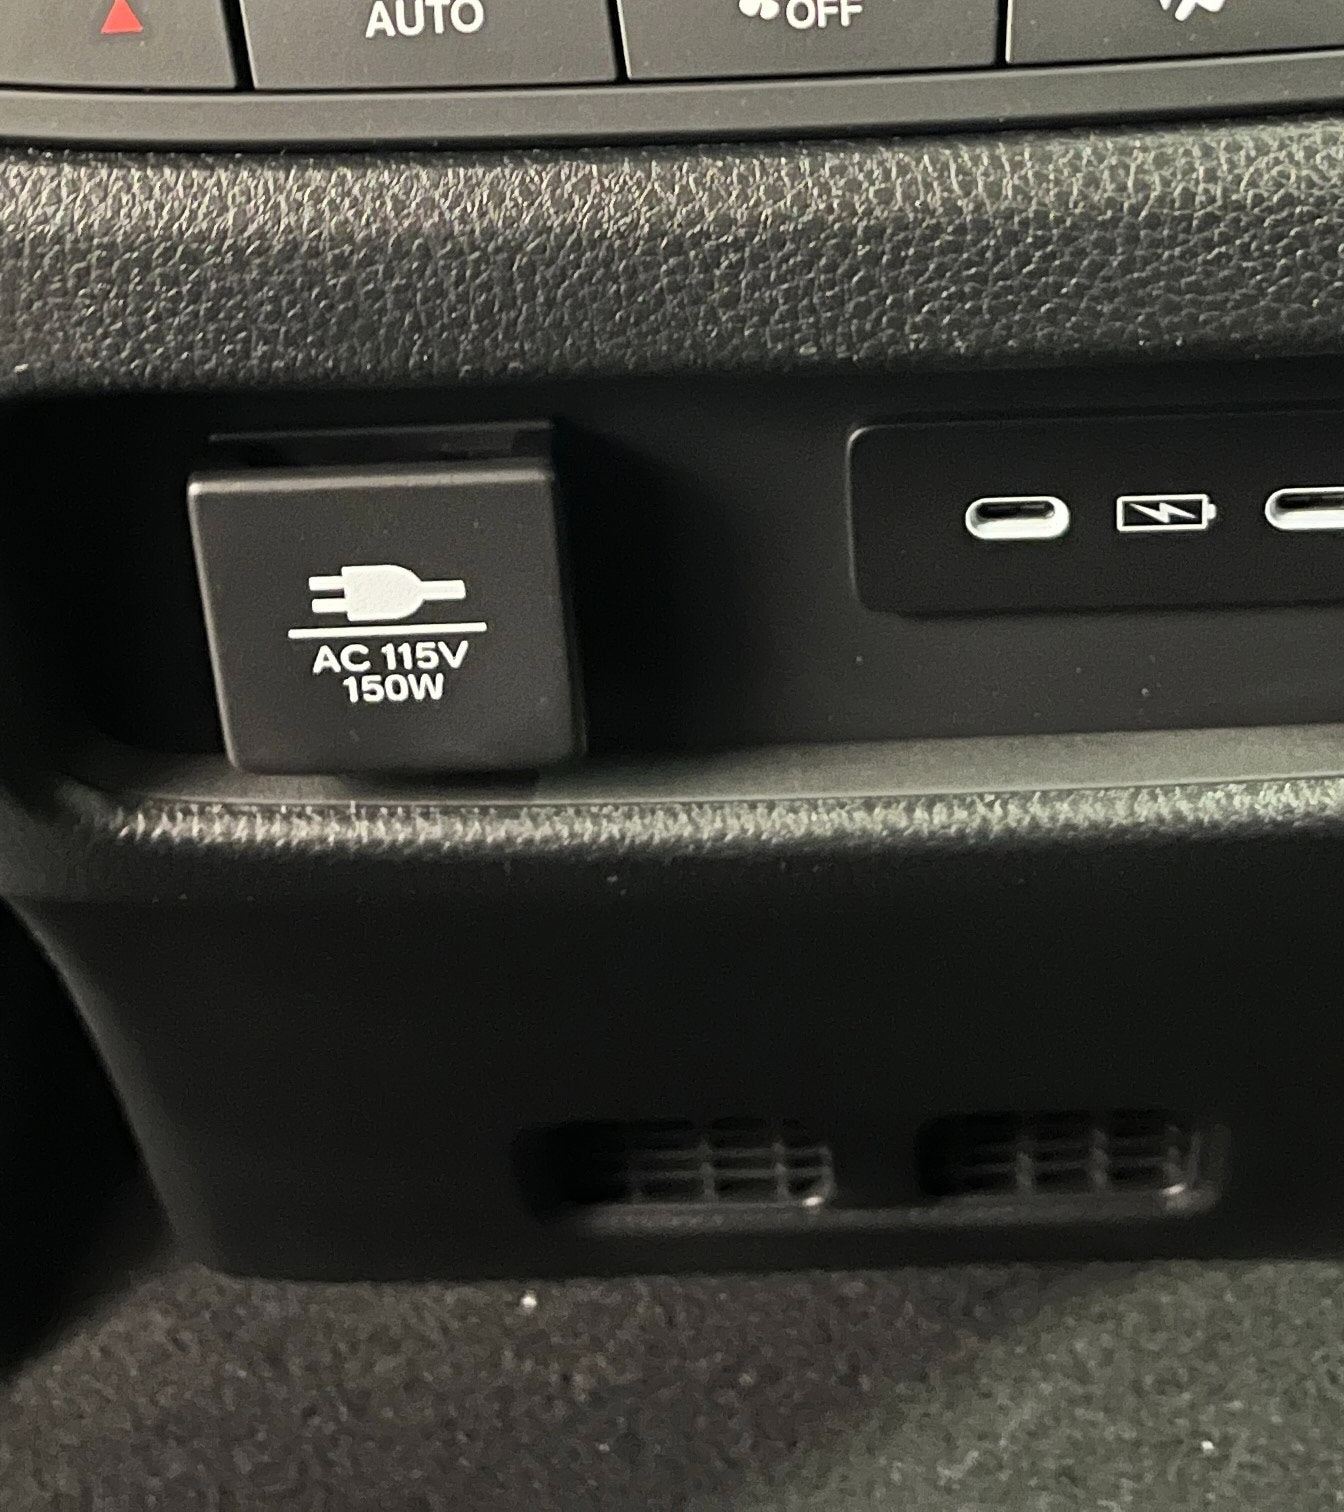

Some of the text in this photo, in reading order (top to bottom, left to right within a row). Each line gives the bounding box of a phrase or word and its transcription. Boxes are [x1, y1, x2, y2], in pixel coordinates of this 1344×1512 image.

[312, 640, 469, 674] AC 115V
[342, 673, 444, 703] 150W
